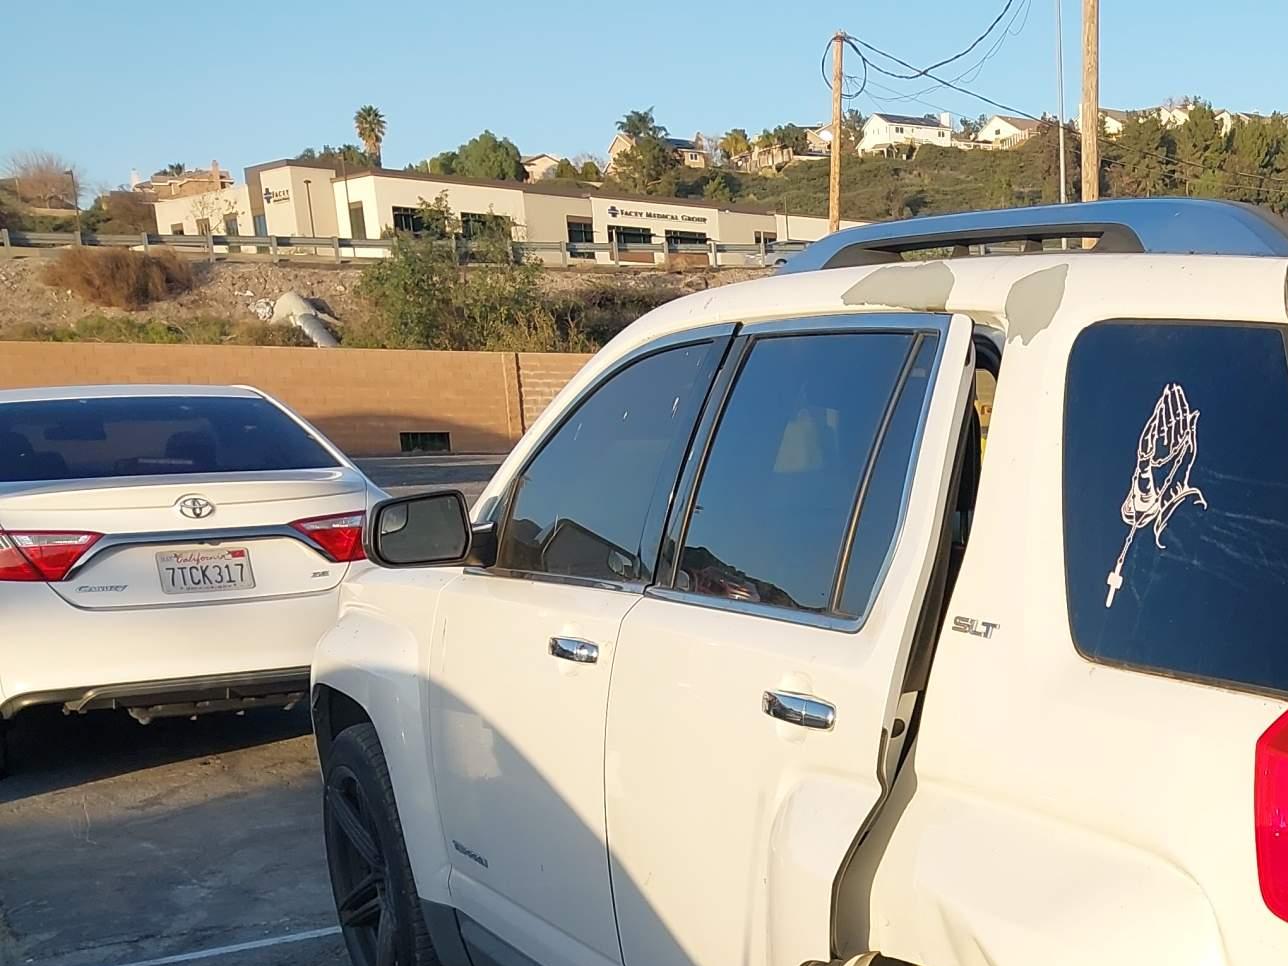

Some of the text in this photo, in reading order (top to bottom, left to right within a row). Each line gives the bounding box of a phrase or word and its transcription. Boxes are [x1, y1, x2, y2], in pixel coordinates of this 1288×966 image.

[620, 209, 707, 224] FACEY MEDICAL GROUP
[174, 553, 226, 565] California
[165, 563, 244, 587] 7TCK317
[952, 616, 1000, 639] SLT
